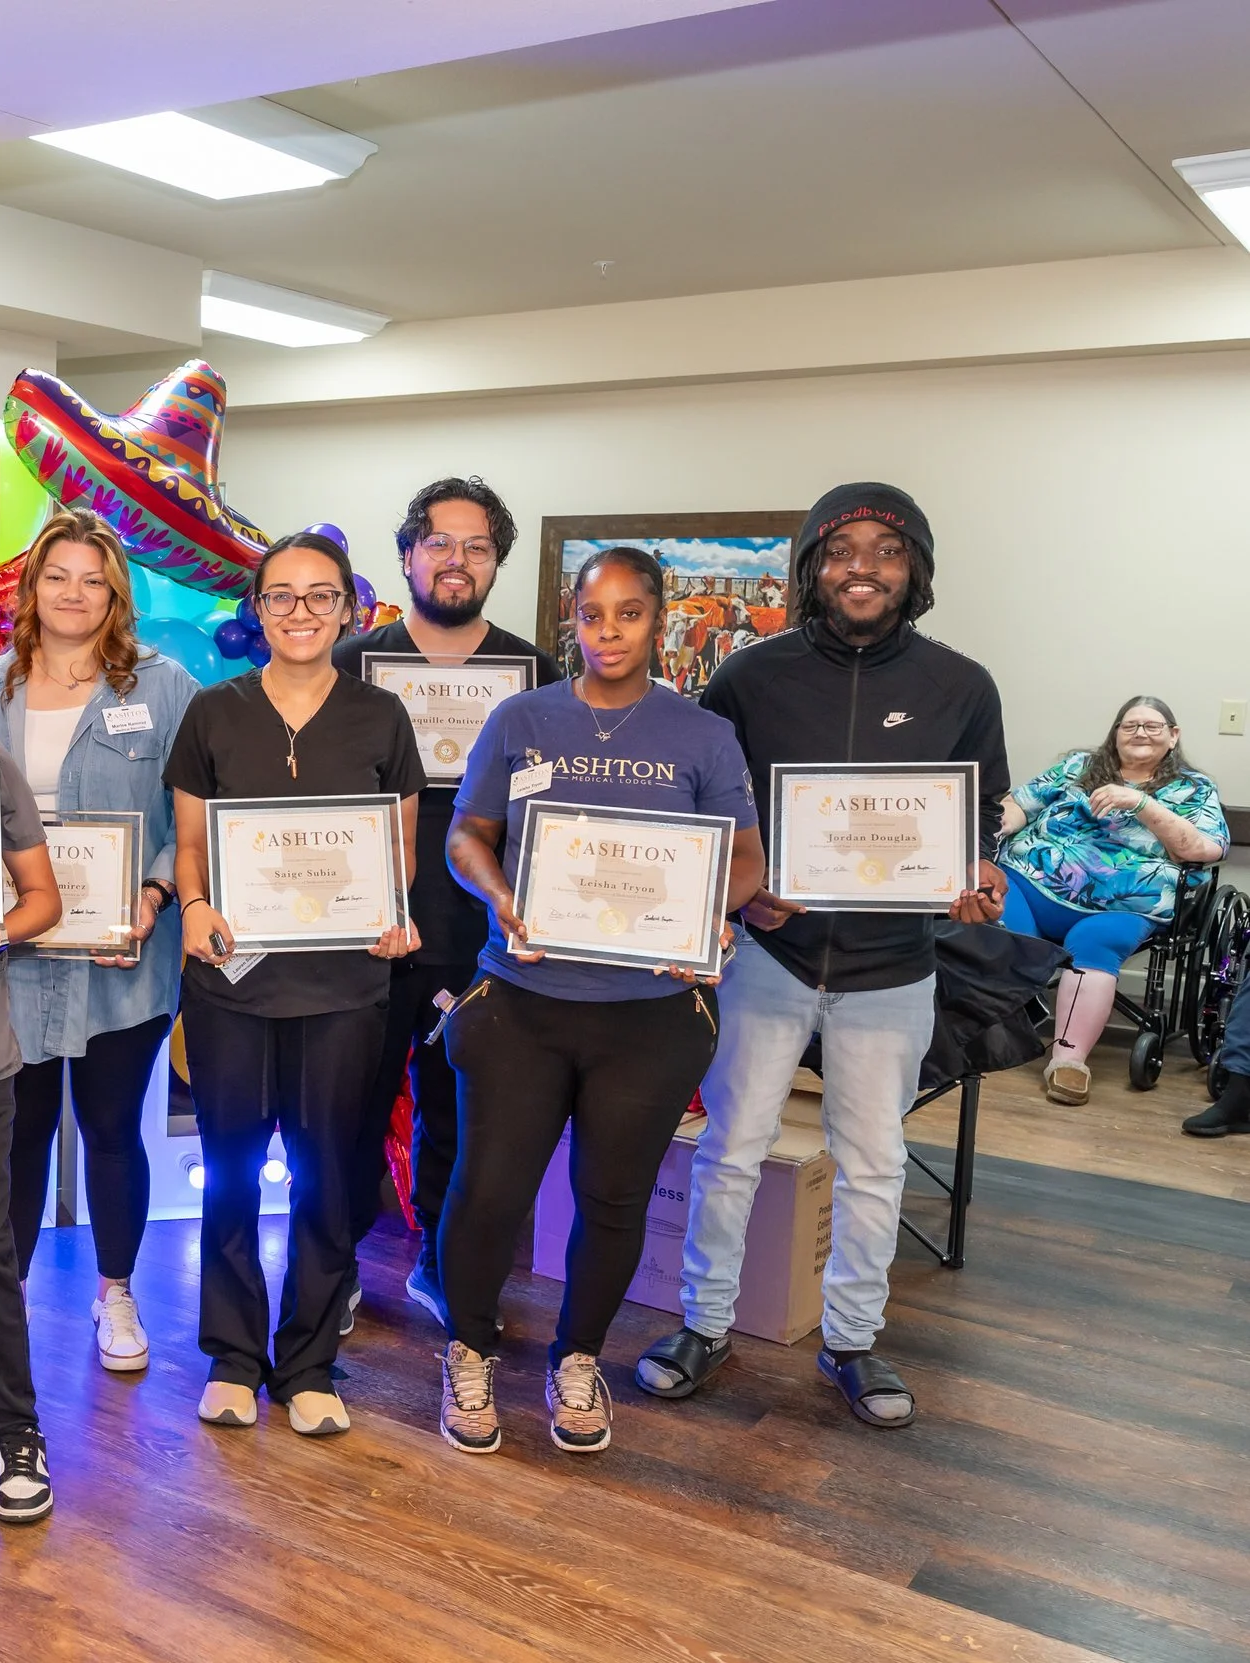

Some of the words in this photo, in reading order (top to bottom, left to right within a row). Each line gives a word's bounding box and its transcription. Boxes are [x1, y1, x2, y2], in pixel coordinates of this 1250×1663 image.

[415, 684, 494, 698] ASHTON
[411, 717, 444, 727] aquille
[448, 717, 485, 726] Ontiver
[888, 712, 906, 722] NIKE
[552, 756, 676, 782] ASHTON
[572, 776, 614, 784] MEDICAL
[620, 778, 652, 786] LODGE
[835, 797, 927, 811] ASHTON
[268, 830, 355, 847] ASHTON
[826, 833, 866, 844] Jordan
[871, 833, 917, 844] Douglas
[49, 846, 95, 860] TON
[583, 841, 677, 863] ASHTON
[274, 870, 303, 880] Saige
[307, 868, 337, 877] Subia
[58, 882, 86, 890] mirez
[580, 878, 616, 890] Leisha
[622, 882, 655, 894] Tryon
[654, 1183, 685, 1202] less
